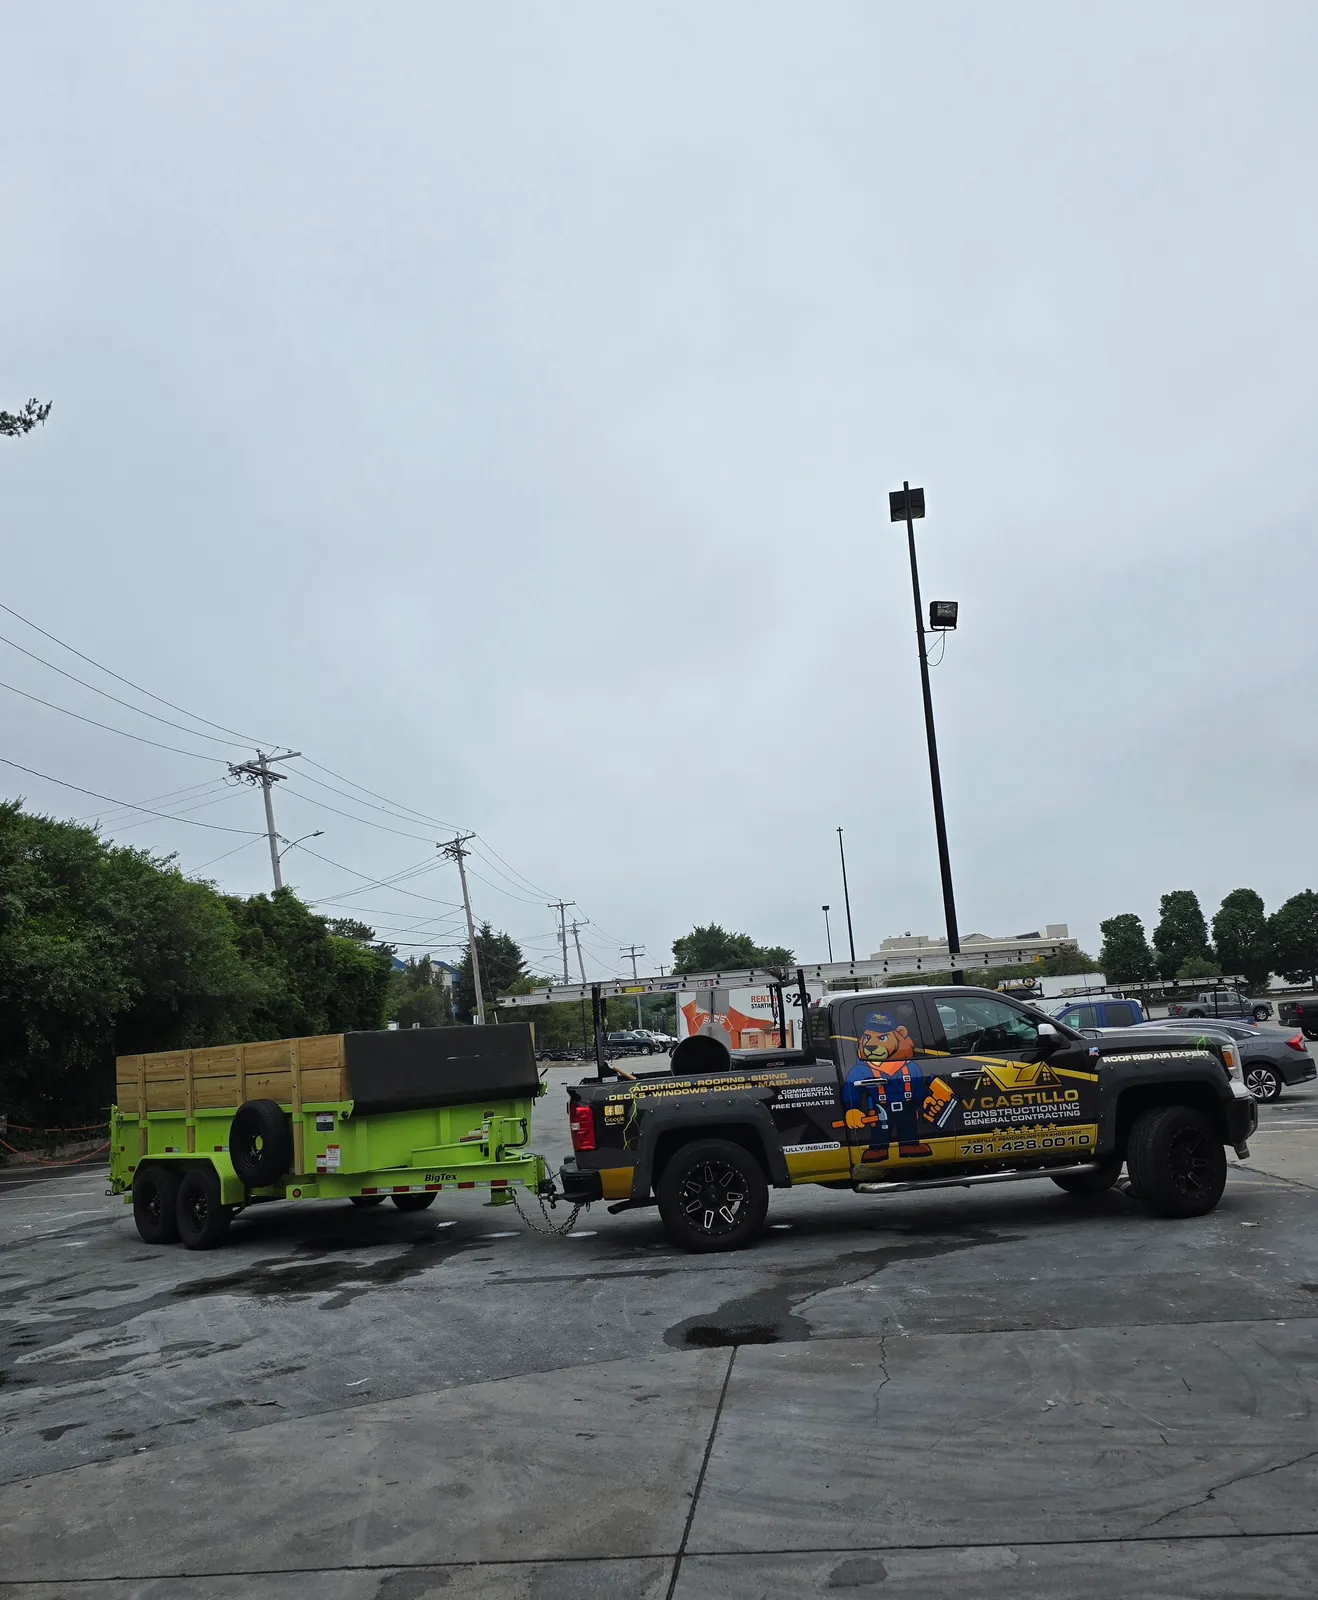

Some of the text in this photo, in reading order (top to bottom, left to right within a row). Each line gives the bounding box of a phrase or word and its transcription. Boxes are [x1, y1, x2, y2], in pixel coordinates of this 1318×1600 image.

[1102, 1050, 1210, 1063] ROOF REPAIR EXPERT
[609, 1077, 814, 1101] DECKS WINDOWS DOORS MASONRY
[633, 1073, 788, 1092] ADDITIONS ROOFING SIDING
[781, 1086, 833, 1095] COMMERCIAL
[784, 1091, 834, 1100] RESIDENTIAL
[791, 1100, 835, 1108] ESTIMATES
[962, 1089, 1079, 1110] V CASTILLO
[963, 1102, 1080, 1119] CONSTRUCTION INC
[964, 1110, 1081, 1126] GENERAL CONTRACTING
[805, 1143, 840, 1151] INSURED
[960, 1135, 1090, 1156] 781.428.0010
[425, 1173, 458, 1183] BigTex
